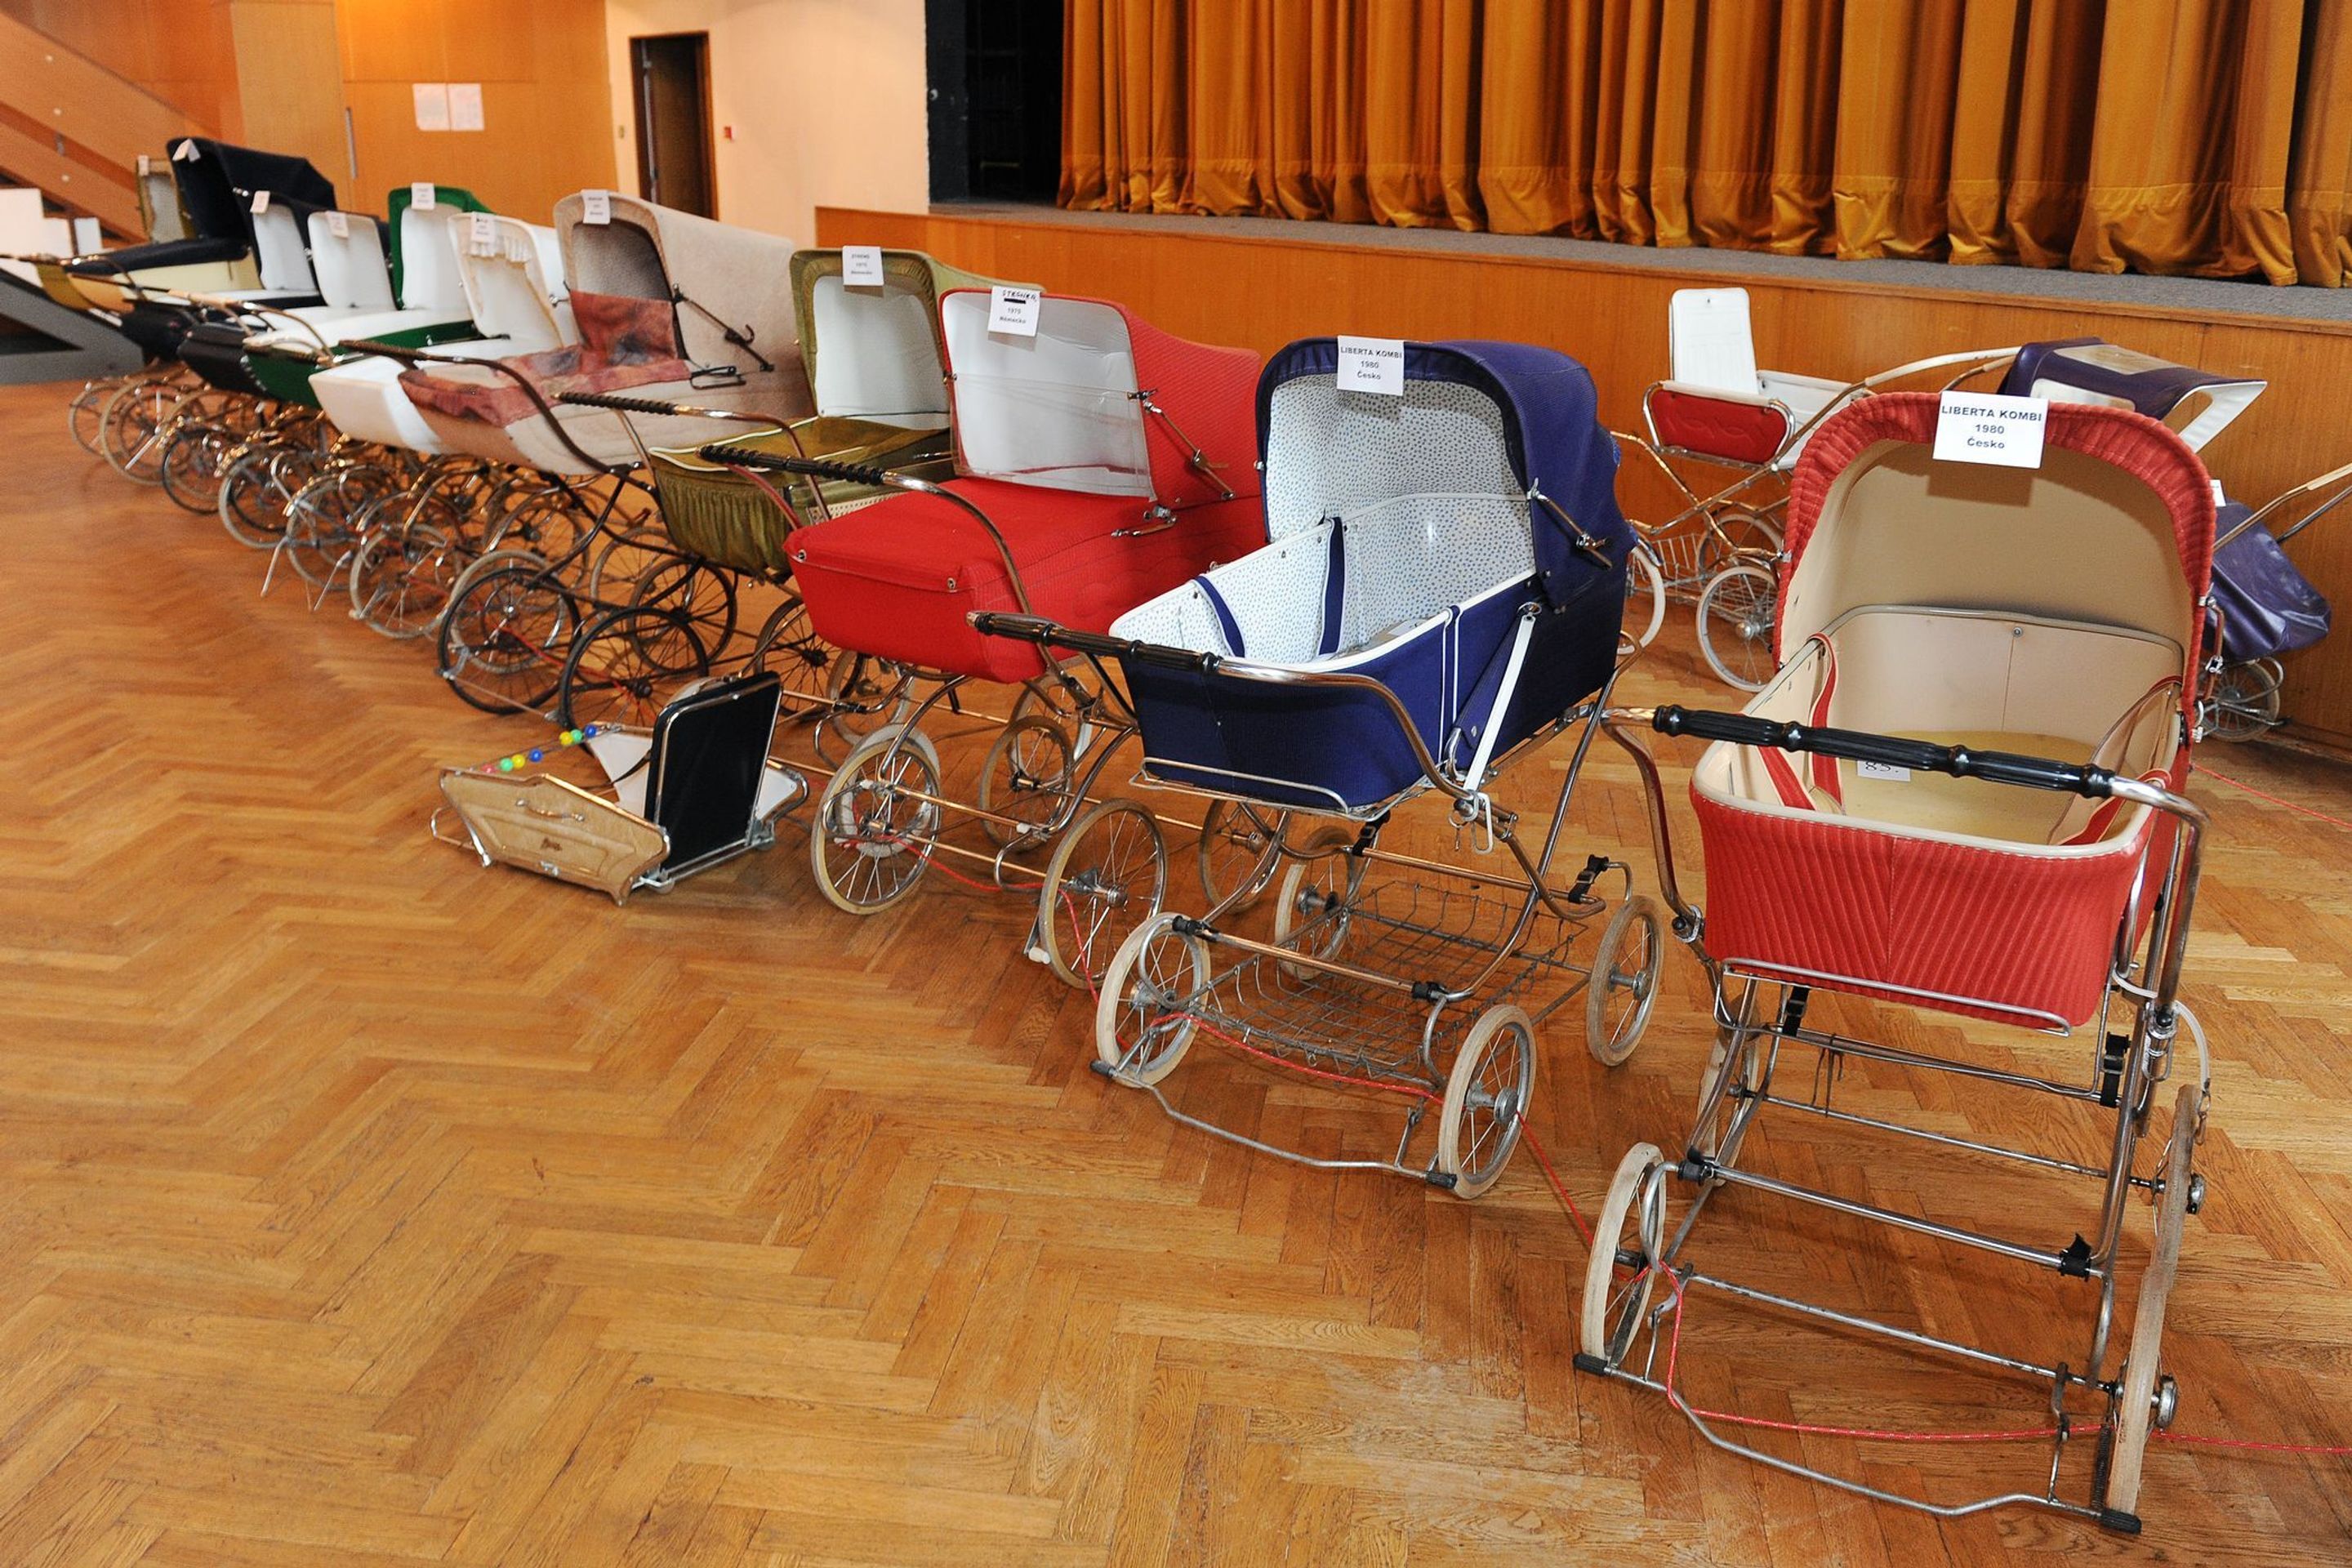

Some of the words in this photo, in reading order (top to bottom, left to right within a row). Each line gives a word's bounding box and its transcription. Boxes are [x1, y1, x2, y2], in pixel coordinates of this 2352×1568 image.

[1340, 346, 1374, 356] LIBERTA
[1375, 350, 1402, 359] KOMBI
[1361, 360, 1379, 369] 1980
[1357, 370, 1381, 381] Česko
[1941, 405, 1996, 418] LIBERTA
[1998, 409, 2042, 422] KOMBI
[1975, 423, 2005, 434] 1980
[1967, 436, 2006, 449] Česko
